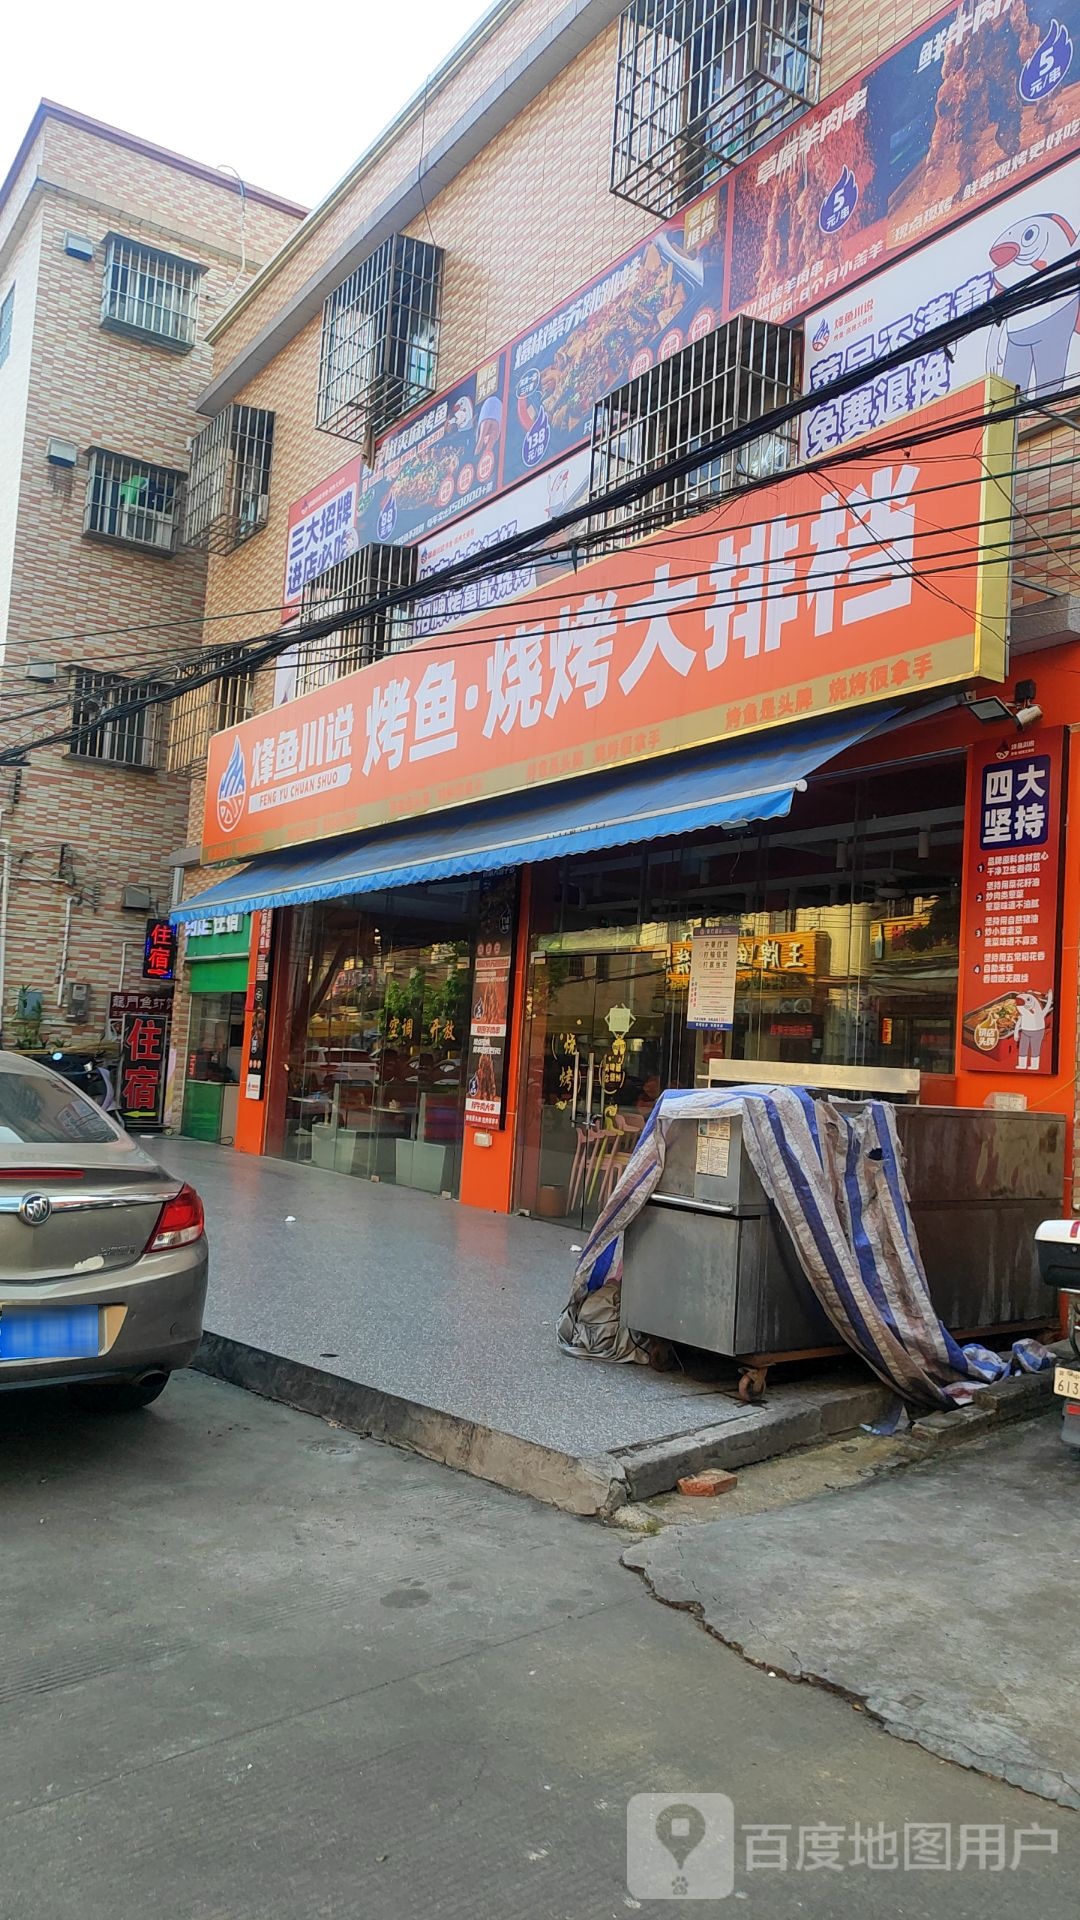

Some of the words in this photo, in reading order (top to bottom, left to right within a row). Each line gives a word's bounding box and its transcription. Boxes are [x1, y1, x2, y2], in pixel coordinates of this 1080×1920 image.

[913, 0, 1013, 74] 鲜牛肉
[1039, 47, 1054, 76] 5
[1030, 66, 1061, 97] 元/串
[756, 86, 868, 187] 草原羊肉串
[826, 206, 850, 230] 元/串
[834, 189, 845, 212] 5
[806, 350, 951, 458] 免费退换
[527, 430, 546, 450] 138
[290, 490, 352, 560] 三大招牌
[381, 512, 393, 526] 88
[829, 652, 933, 704] 烧烤很拿手
[259, 792, 277, 807] FENG
[279, 789, 288, 799] YU
[290, 782, 315, 797] CHUAN
[317, 771, 338, 789] SHUO
[986, 765, 1045, 804] 四大
[983, 803, 1045, 843] 坚持
[987, 863, 1040, 876] 干净卫生看得见
[149, 923, 172, 968] 住宿
[389, 1016, 413, 1039] 空调
[122, 1019, 162, 1109] 住宿
[559, 1033, 577, 1092] 烧烤
